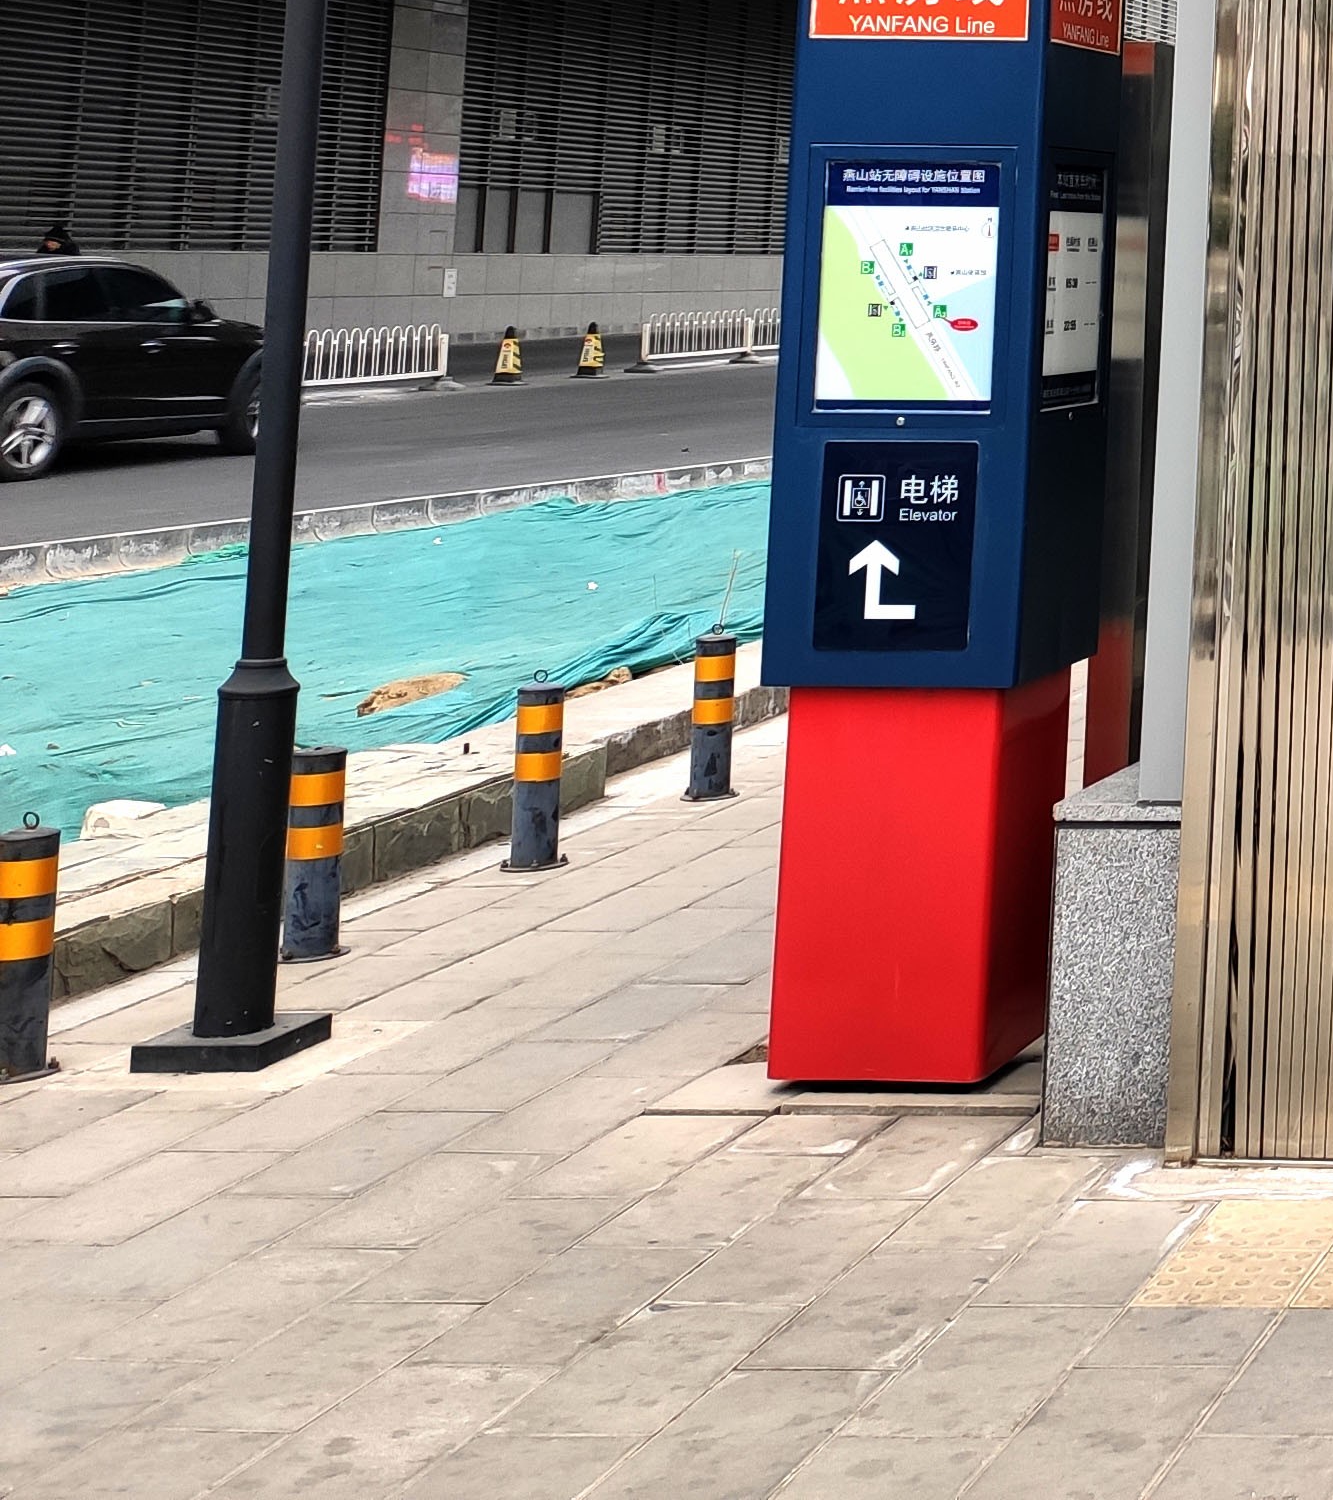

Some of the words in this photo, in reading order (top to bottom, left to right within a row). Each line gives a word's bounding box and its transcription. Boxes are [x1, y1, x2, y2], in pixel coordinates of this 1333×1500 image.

[849, 15, 949, 34] YANFANG
[955, 16, 996, 35] Line
[1062, 21, 1096, 45] YANFANG
[1097, 31, 1110, 48] Line
[842, 168, 986, 183] 燕山站无障碍设施位置图
[900, 475, 959, 504] 电梯
[899, 508, 958, 522] Elevator
